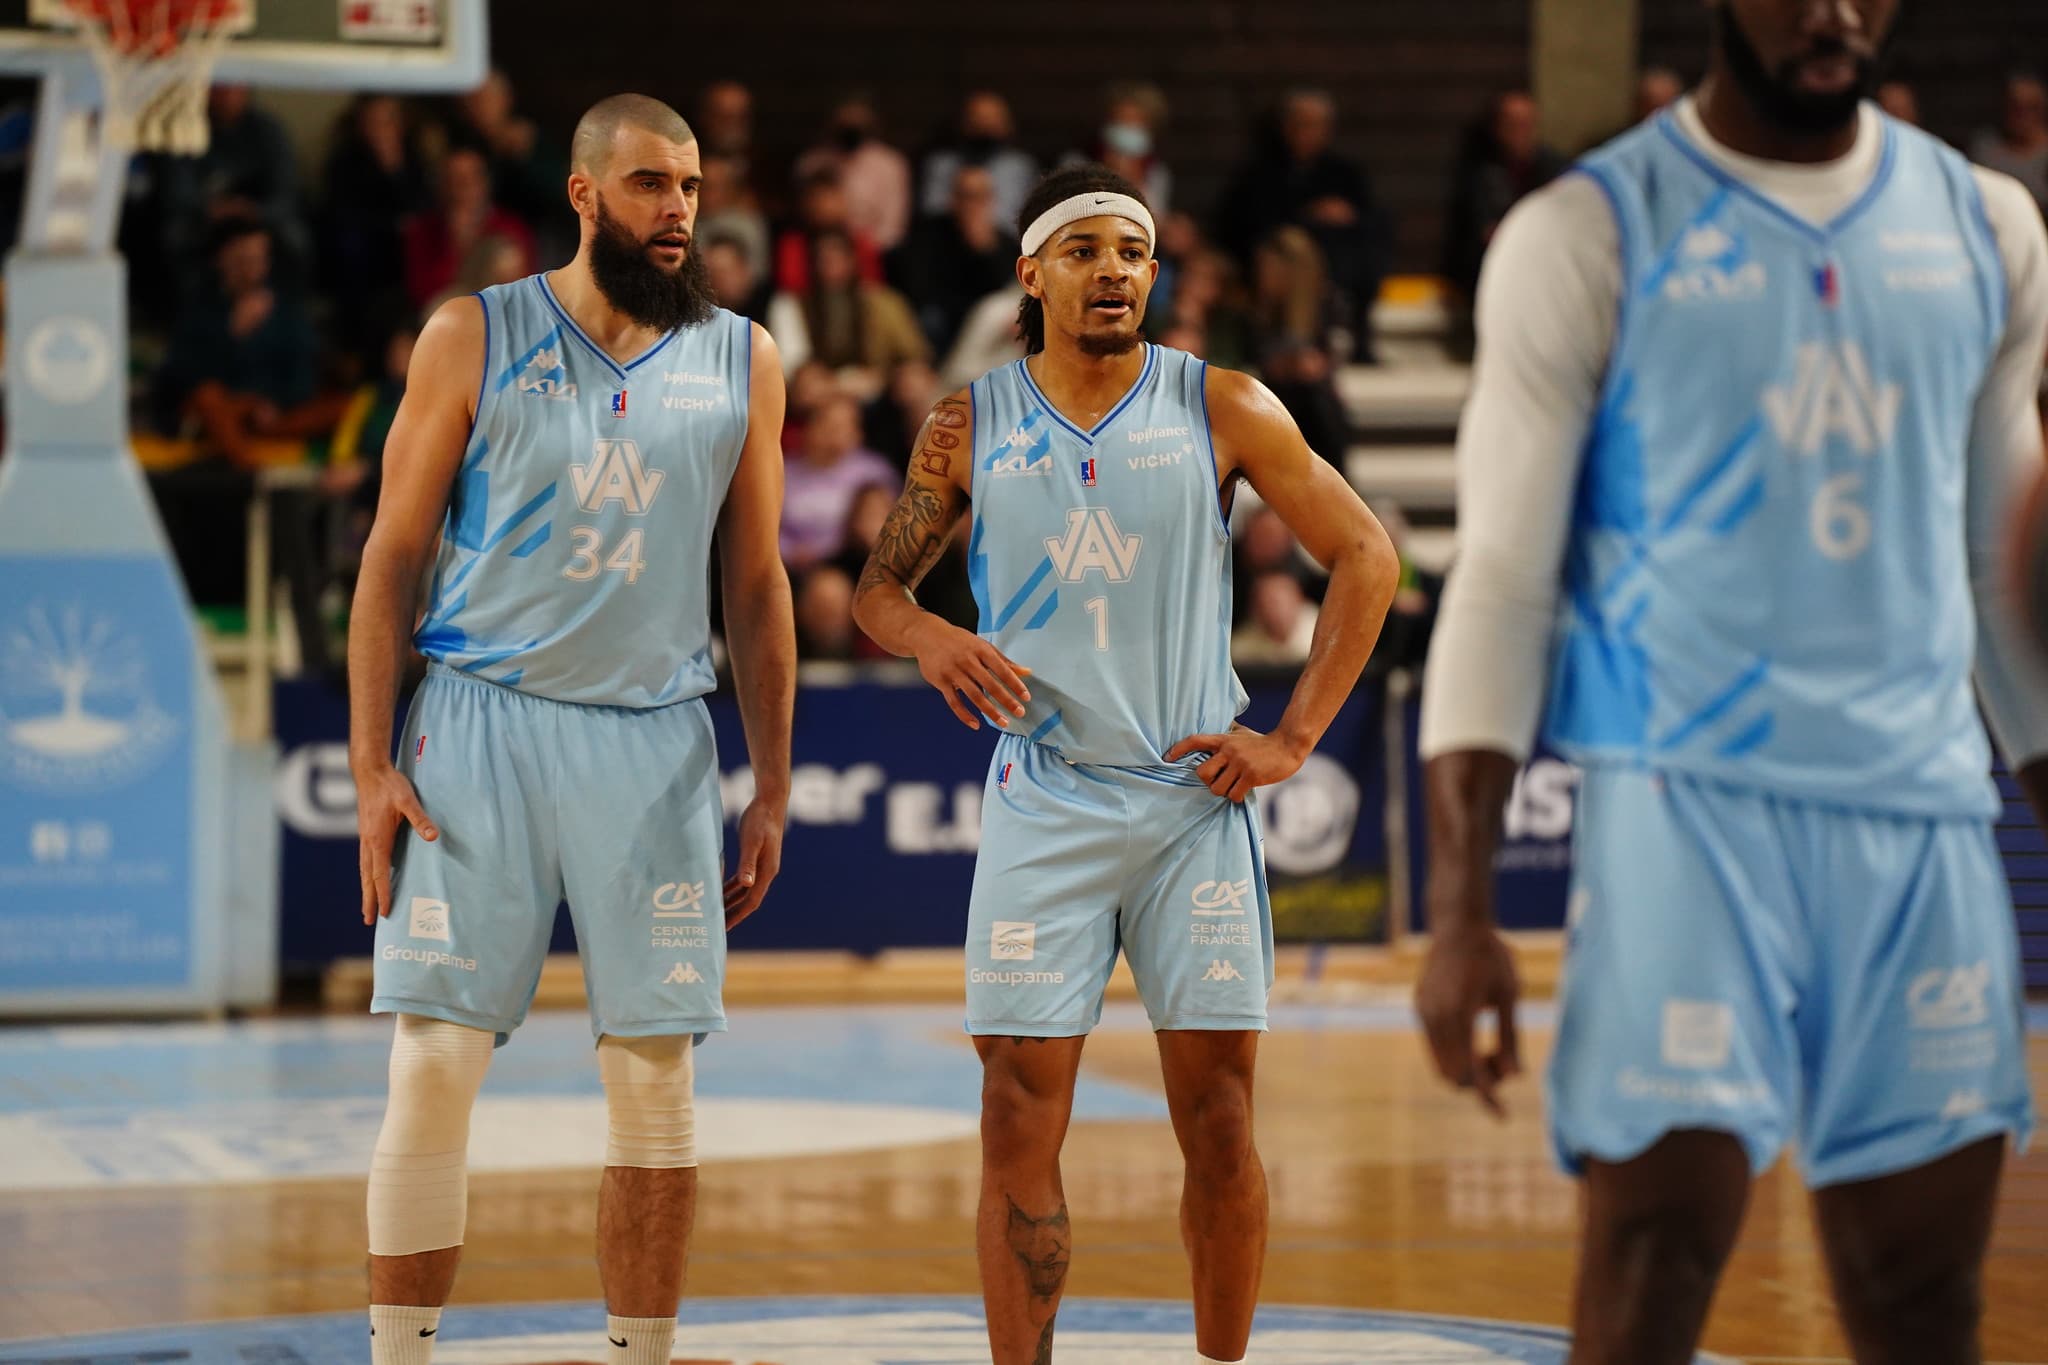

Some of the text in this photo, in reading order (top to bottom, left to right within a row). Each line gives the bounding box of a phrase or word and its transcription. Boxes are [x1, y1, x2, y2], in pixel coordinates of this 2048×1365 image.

[662, 396, 715, 413] VICHY
[993, 454, 1053, 473] KIA
[1127, 452, 1182, 470] VICHY
[1808, 471, 1872, 561] 6
[562, 524, 647, 585] 34
[1084, 595, 1109, 651] 1
[651, 926, 708, 936] CENTRE
[1190, 923, 1249, 934] CENTRE
[651, 938, 709, 948] FRANCE
[1190, 935, 1251, 945] FRANCE
[382, 944, 477, 971] Groupama
[970, 967, 1064, 987] Groupama
